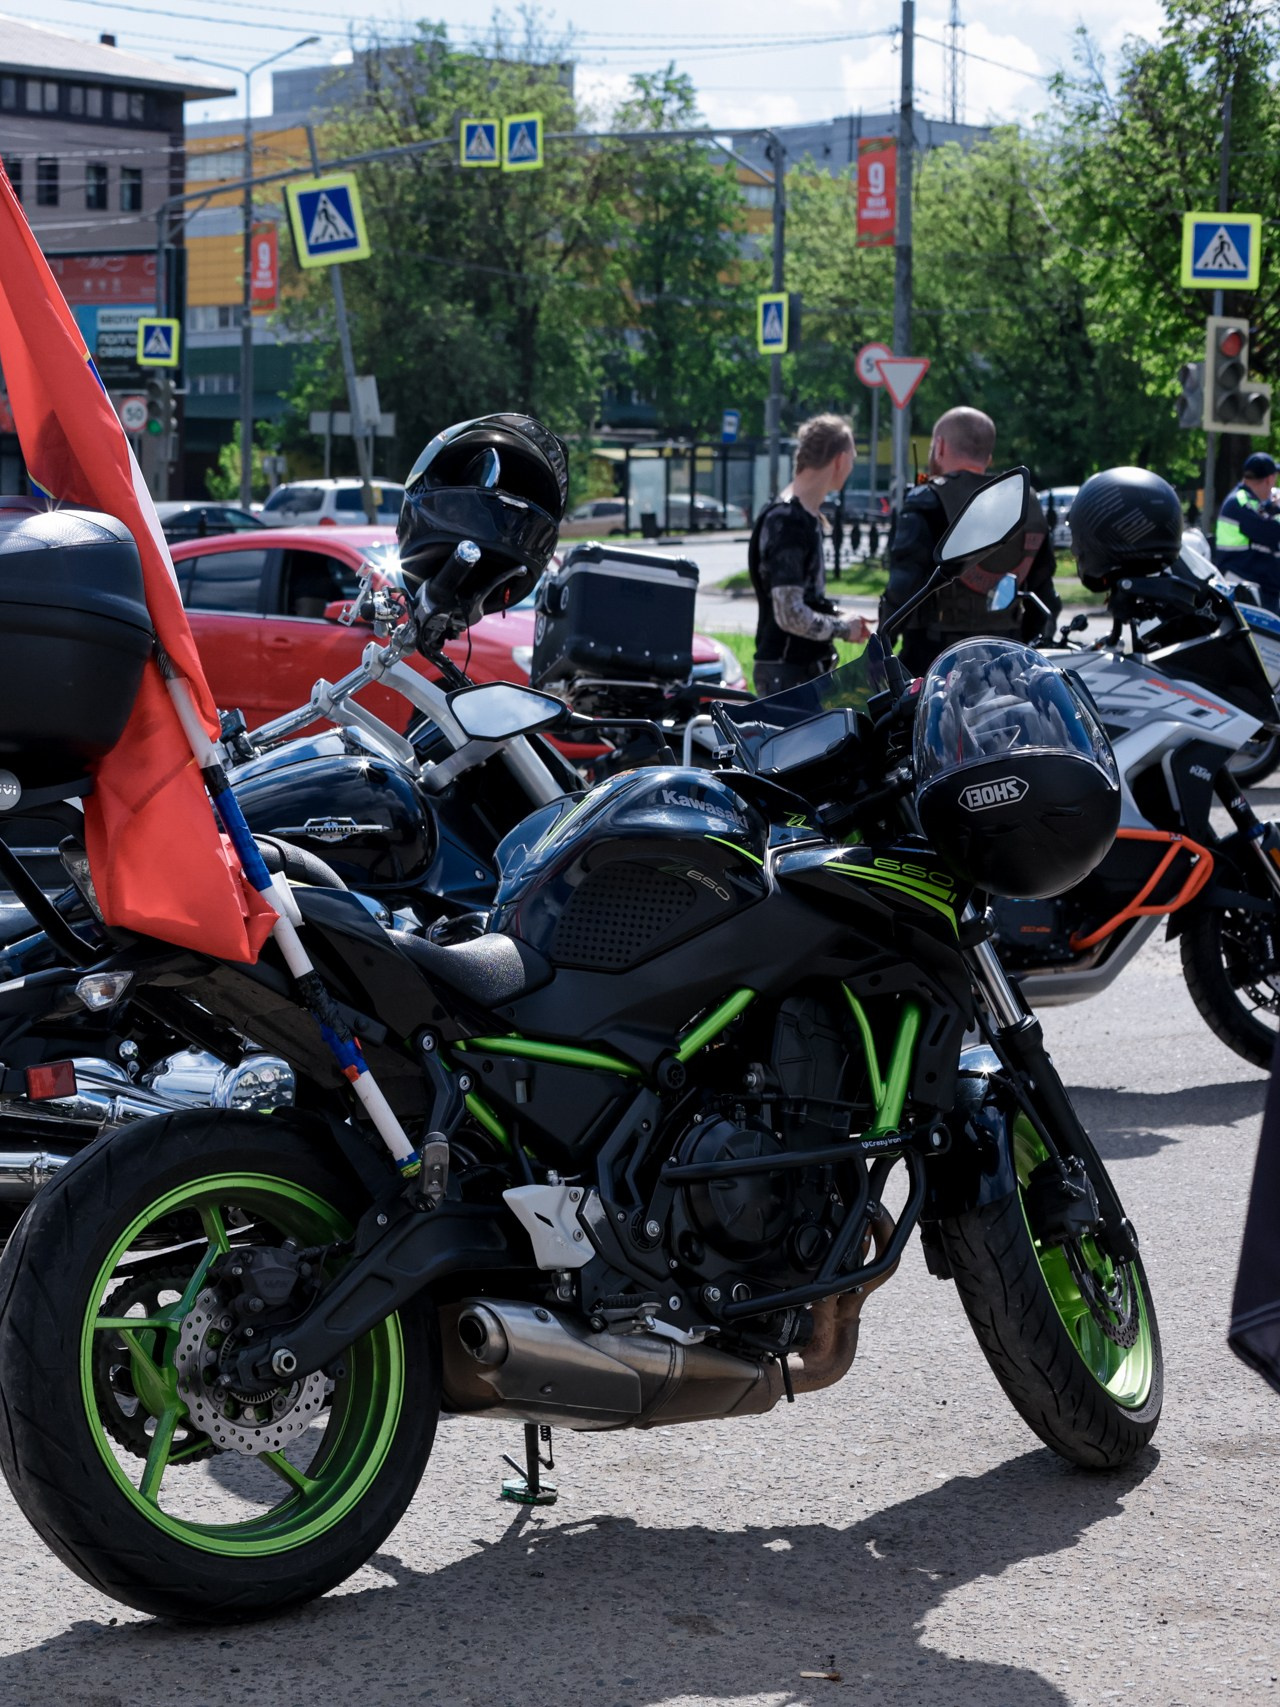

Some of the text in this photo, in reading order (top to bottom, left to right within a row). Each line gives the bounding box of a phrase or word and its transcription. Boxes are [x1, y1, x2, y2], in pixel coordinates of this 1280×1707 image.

[868, 162, 885, 195] 9
[257, 241, 270, 269] 9
[126, 405, 143, 420] 50
[1189, 764, 1212, 781] KTM
[965, 780, 1020, 808] SHOEI
[662, 789, 749, 830] Kawasaki
[686, 868, 731, 901] 650
[873, 857, 954, 888] 650
